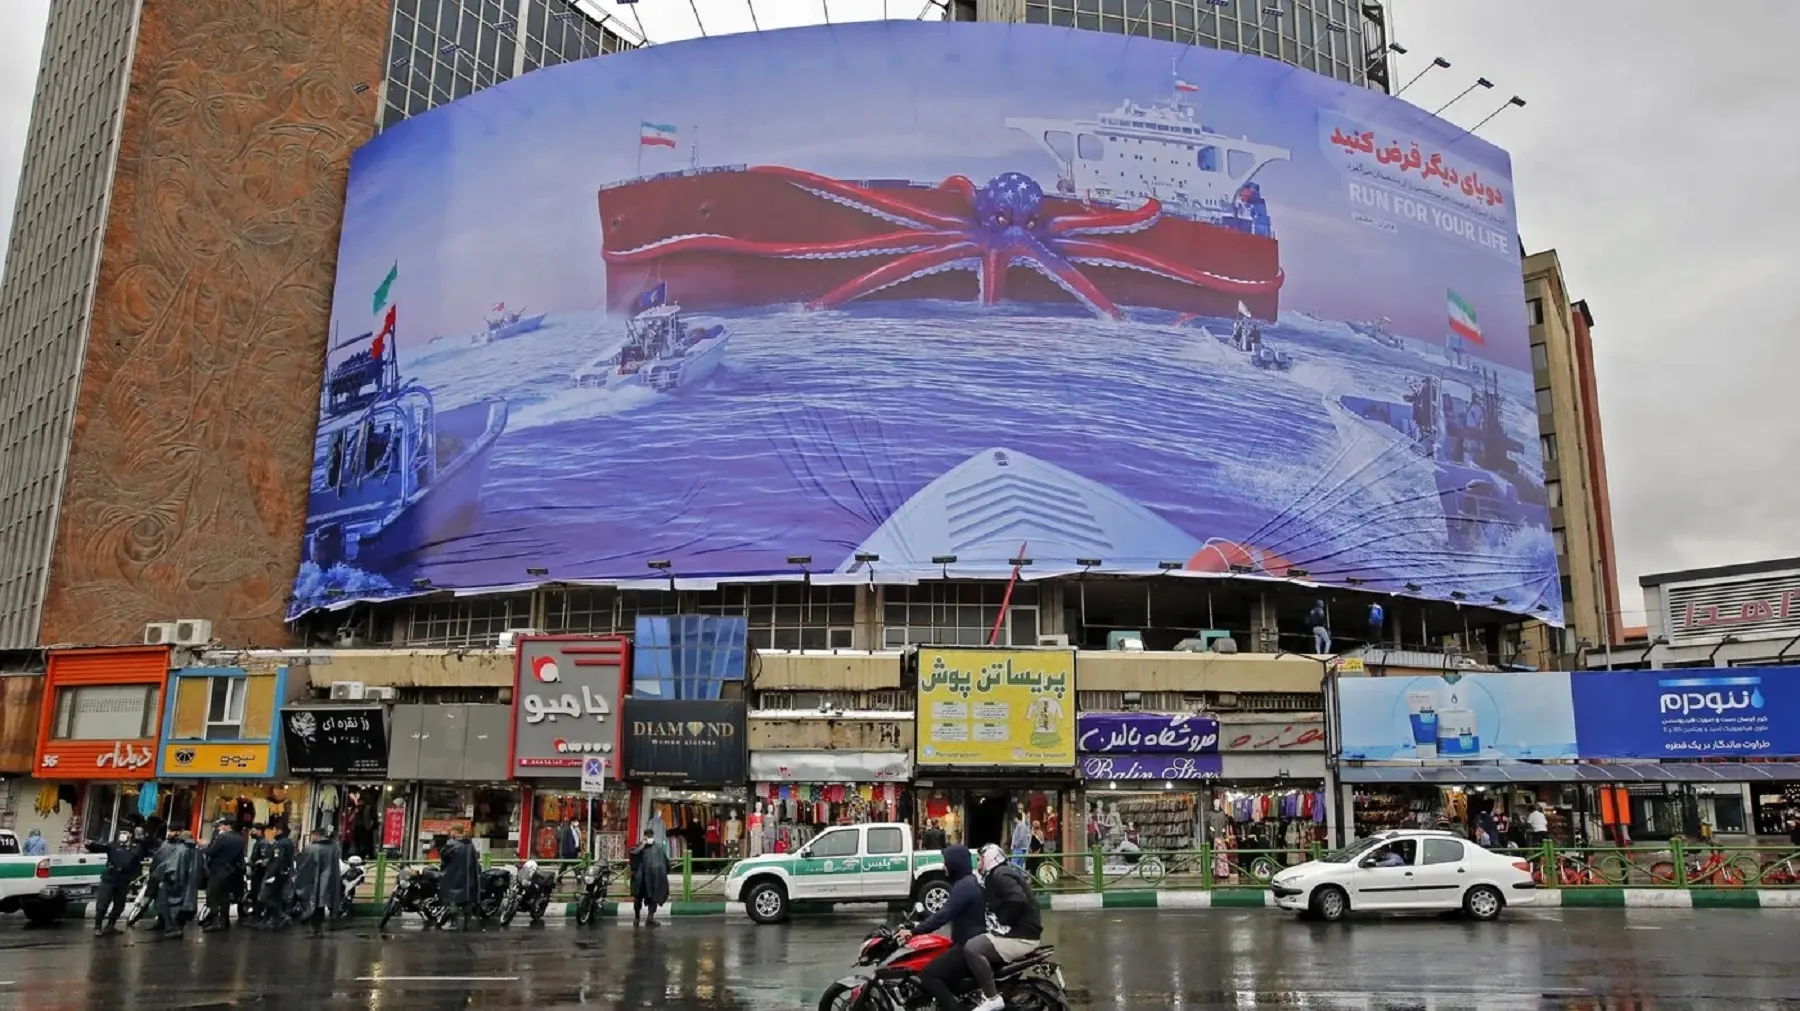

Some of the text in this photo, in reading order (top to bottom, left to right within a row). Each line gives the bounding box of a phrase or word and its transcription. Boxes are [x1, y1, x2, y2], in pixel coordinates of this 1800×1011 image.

[1330, 127, 1374, 155] کنید
[1376, 139, 1422, 171] قرض
[1421, 153, 1459, 188] دیگر
[1460, 172, 1487, 204] پای
[1486, 187, 1504, 207] دو
[1349, 183, 1389, 212] RUN
[1394, 196, 1428, 224] FOR
[1431, 208, 1475, 241] YOUR
[1479, 226, 1509, 254] LIFE
[921, 657, 1066, 699] پریسا تن پوش
[524, 685, 611, 723] جامبو
[322, 716, 335, 731] ای
[338, 716, 358, 731] نقره
[1144, 716, 1217, 751] فروشگاه
[1080, 724, 1141, 752] بالین
[1665, 740, 1770, 751] طراوت ماندگار در یک قطره
[1084, 757, 1155, 779] Balin
[863, 858, 891, 871] پلیس
